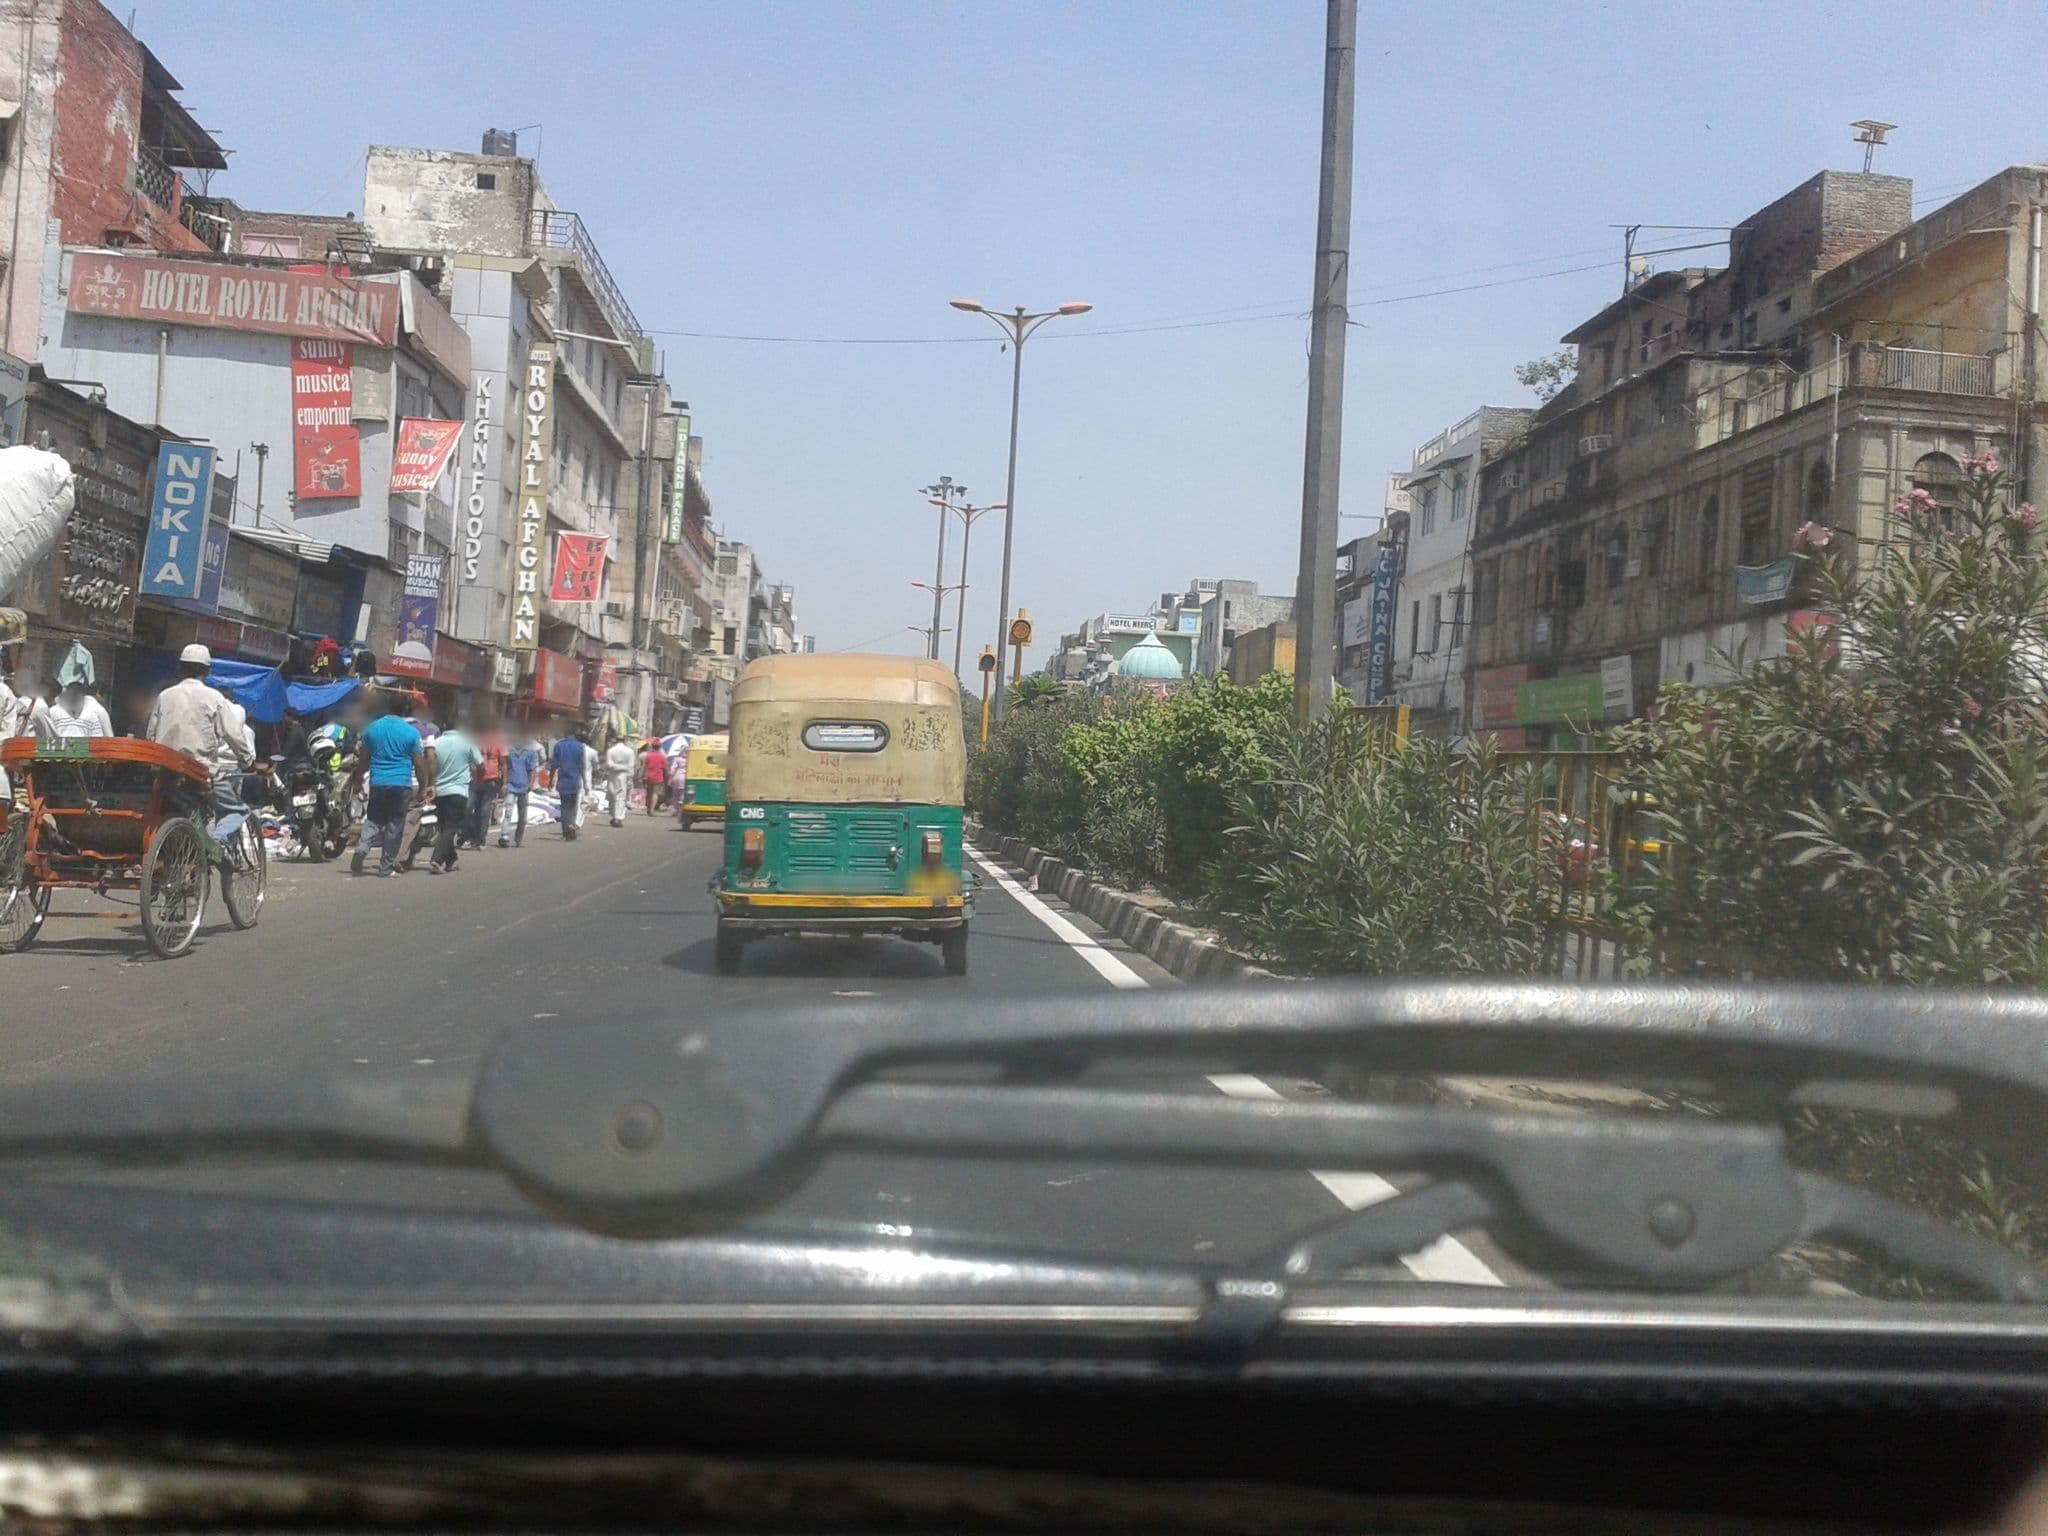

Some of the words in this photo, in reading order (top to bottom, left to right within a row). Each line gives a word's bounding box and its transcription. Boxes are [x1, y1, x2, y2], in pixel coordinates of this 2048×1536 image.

[140, 269, 212, 316] HOTEL
[217, 276, 288, 323] ROYAL
[295, 285, 384, 334] AFGHAN
[300, 340, 345, 364] sunny
[296, 366, 352, 394] musica
[297, 400, 352, 433] emporiu
[472, 375, 492, 464] KHAN
[525, 365, 547, 485] ROYAL
[153, 453, 201, 585] NOKIA
[465, 471, 485, 580] FOODS
[406, 577, 439, 589] MUSICAL
[407, 560, 441, 580] SHAN
[515, 497, 541, 640] AFGHAN
[1110, 619, 1132, 628] HOTEL
[739, 808, 765, 819] CNG
